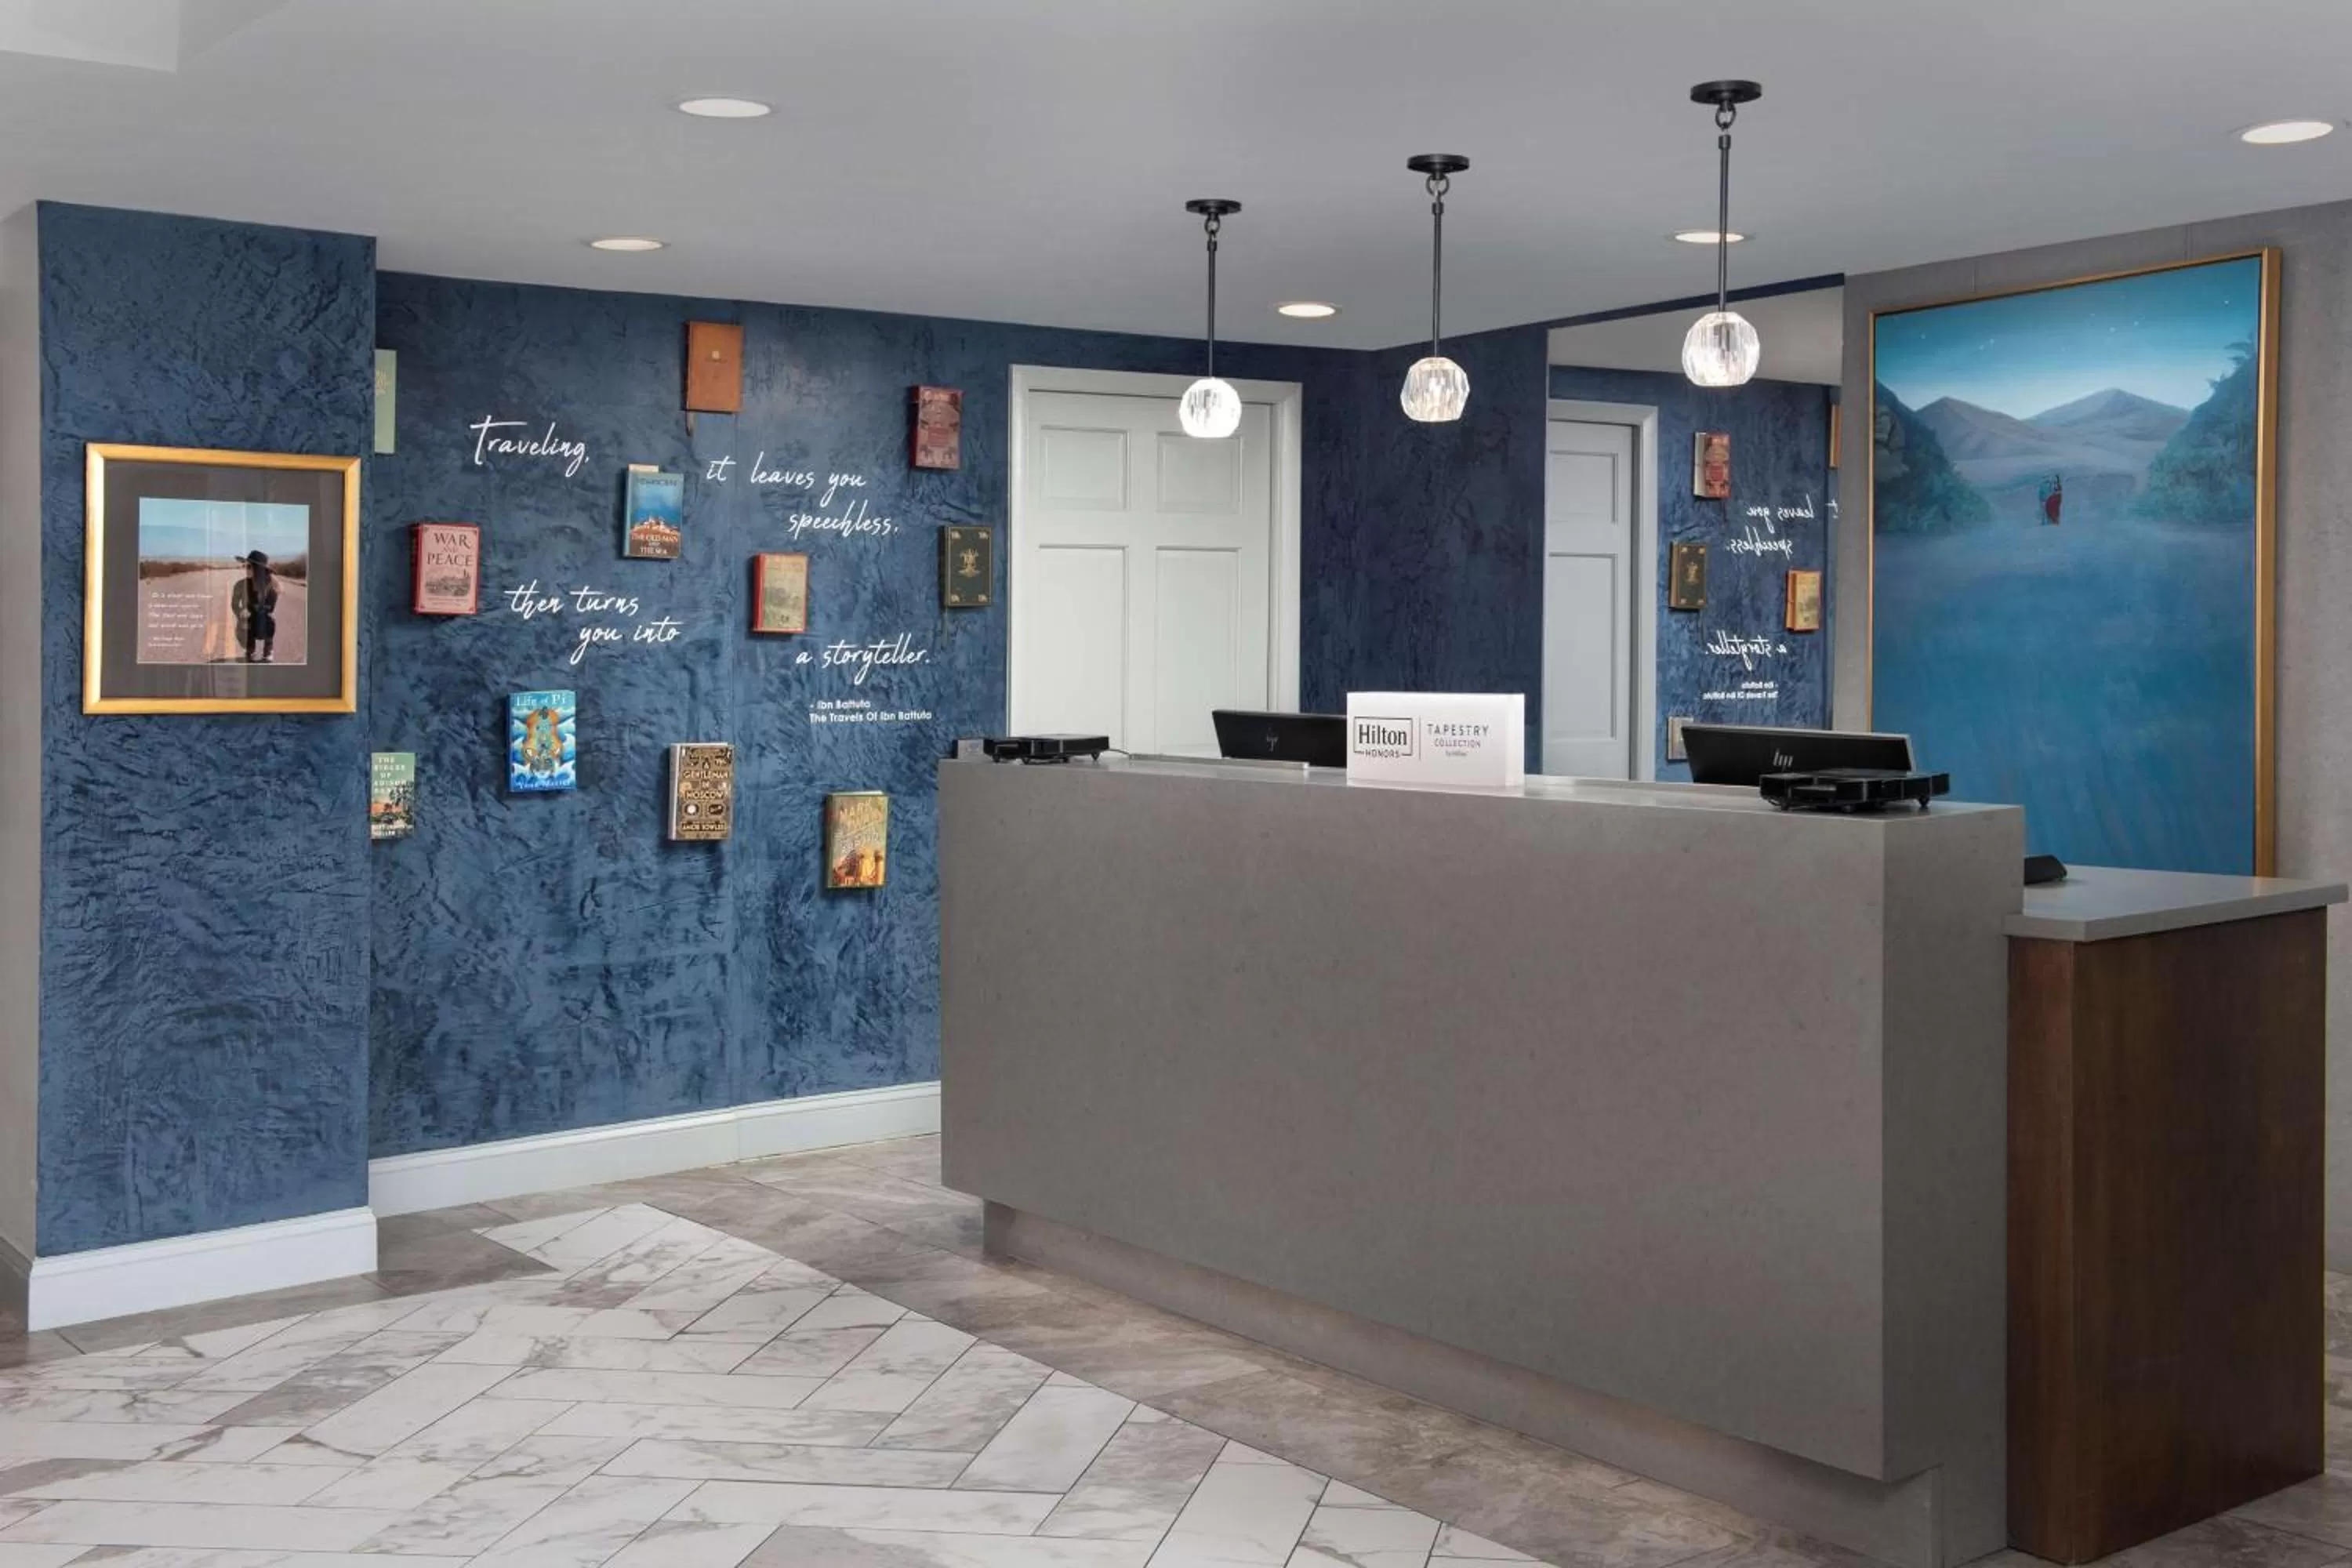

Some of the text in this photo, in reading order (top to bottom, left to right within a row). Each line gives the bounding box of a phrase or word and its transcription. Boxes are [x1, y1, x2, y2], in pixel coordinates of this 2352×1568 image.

[470, 414, 590, 477] Traveling,
[706, 451, 867, 508] it leaves you
[787, 499, 899, 539] speechless.
[434, 532, 471, 550] WAR
[426, 552, 474, 566] PEACE
[504, 579, 640, 619] then turns
[570, 616, 684, 665] you into
[796, 632, 931, 685] a storyteller.
[517, 695, 536, 706] Life
[551, 694, 566, 705] Pi
[816, 699, 833, 710] Ibn
[835, 699, 871, 710] Battuta
[809, 710, 932, 724] The Travels Of Ibn Battuta
[1358, 723, 1408, 746] Hilton
[1427, 723, 1490, 737] TAPESTRY
[1434, 738, 1482, 749] COLLECTION
[1365, 749, 1400, 759] HONORS
